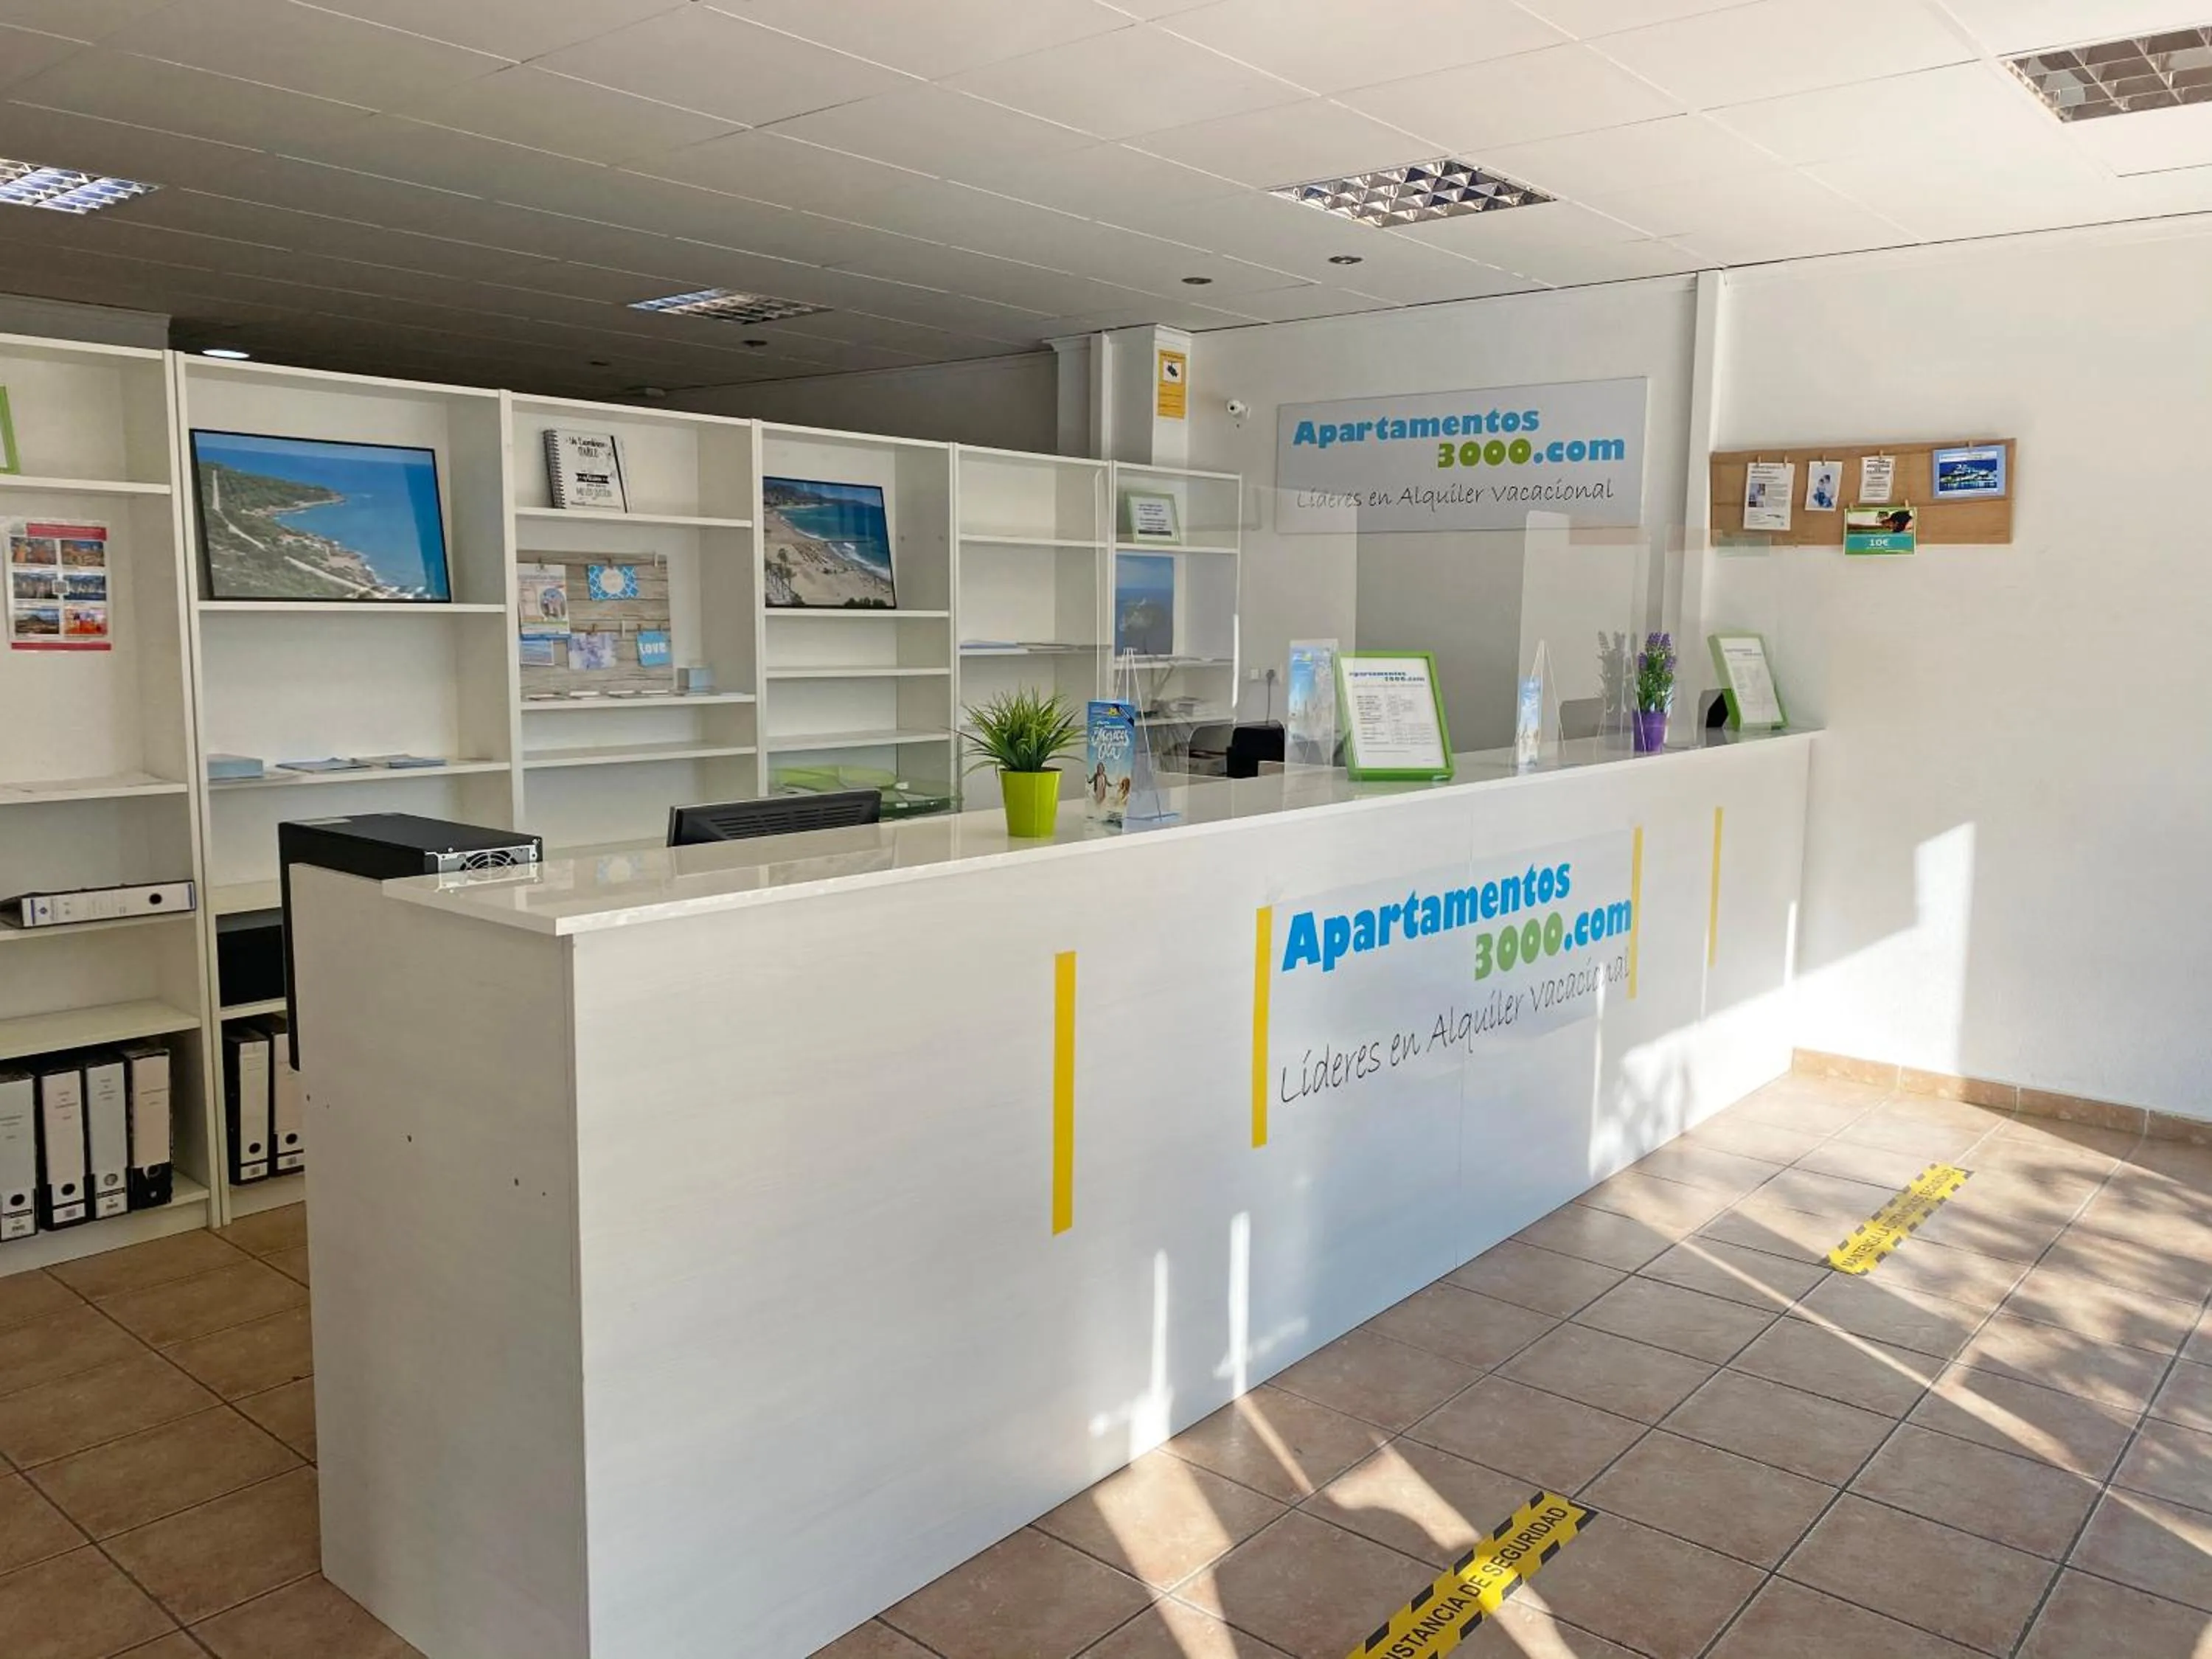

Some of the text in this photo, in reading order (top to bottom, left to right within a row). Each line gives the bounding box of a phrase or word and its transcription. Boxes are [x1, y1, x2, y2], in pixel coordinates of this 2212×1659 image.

[1293, 408, 1540, 449] Apartamentos
[1437, 438, 1624, 468] 3000.com
[1368, 490, 1393, 507] en
[1869, 538, 1889, 547] 10€
[639, 642, 667, 654] LOVE
[1281, 863, 1571, 973] Apartamentos
[1475, 900, 1632, 981] 3000.com
[1280, 1041, 1382, 1102] Líderes
[1390, 1032, 1421, 1067] en
[1380, 1506, 1568, 1659] ISTANCIA DE SEGURIDAD
